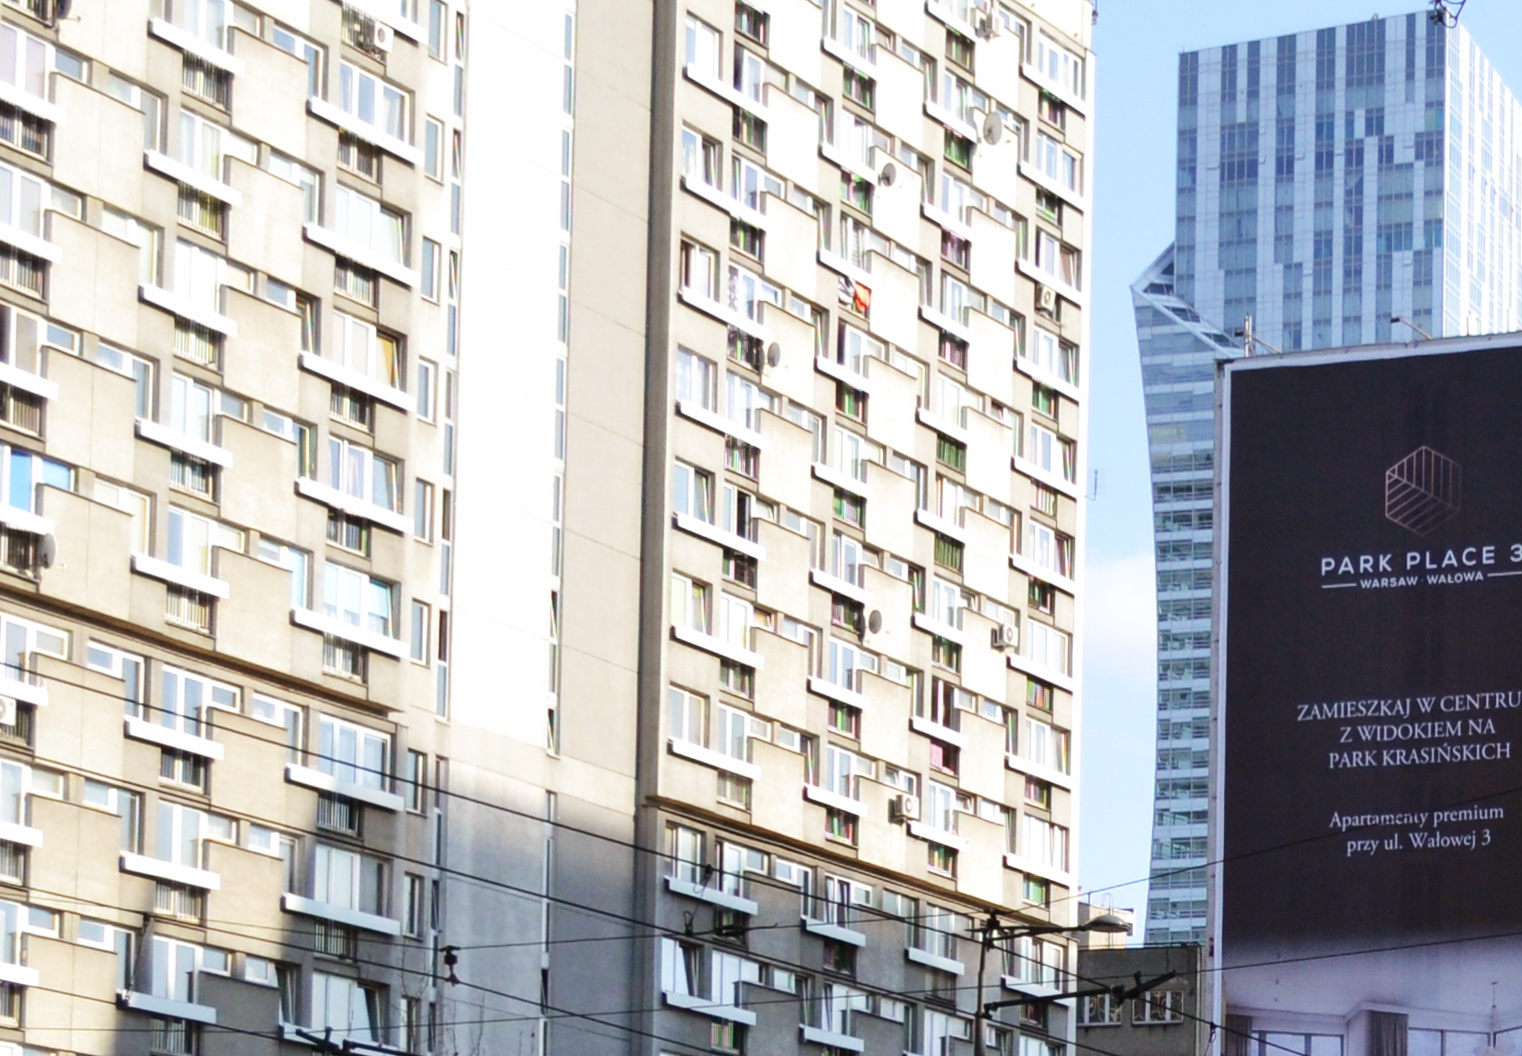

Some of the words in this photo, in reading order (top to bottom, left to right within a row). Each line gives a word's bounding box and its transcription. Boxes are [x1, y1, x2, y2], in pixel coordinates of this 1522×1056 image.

[1321, 554, 1393, 576] PARK
[1406, 546, 1495, 570] PLACE
[1360, 576, 1418, 589] WARSAW
[1427, 571, 1484, 585] WAŁOWA
[1297, 699, 1411, 721] ZAMIESZKAJ
[1417, 697, 1436, 714] W
[1340, 726, 1352, 743] Z
[1357, 720, 1462, 742] WIDOKIEM
[1468, 718, 1496, 736] NA
[1329, 750, 1377, 769] PARK
[1382, 742, 1511, 767] KRASIŃSKICH
[1329, 811, 1429, 832] Apartamenty
[1433, 805, 1504, 828] premium
[1347, 839, 1379, 857] przy
[1384, 833, 1403, 850] ul.
[1409, 830, 1476, 850] Wałowej
[1481, 829, 1491, 846] 3
